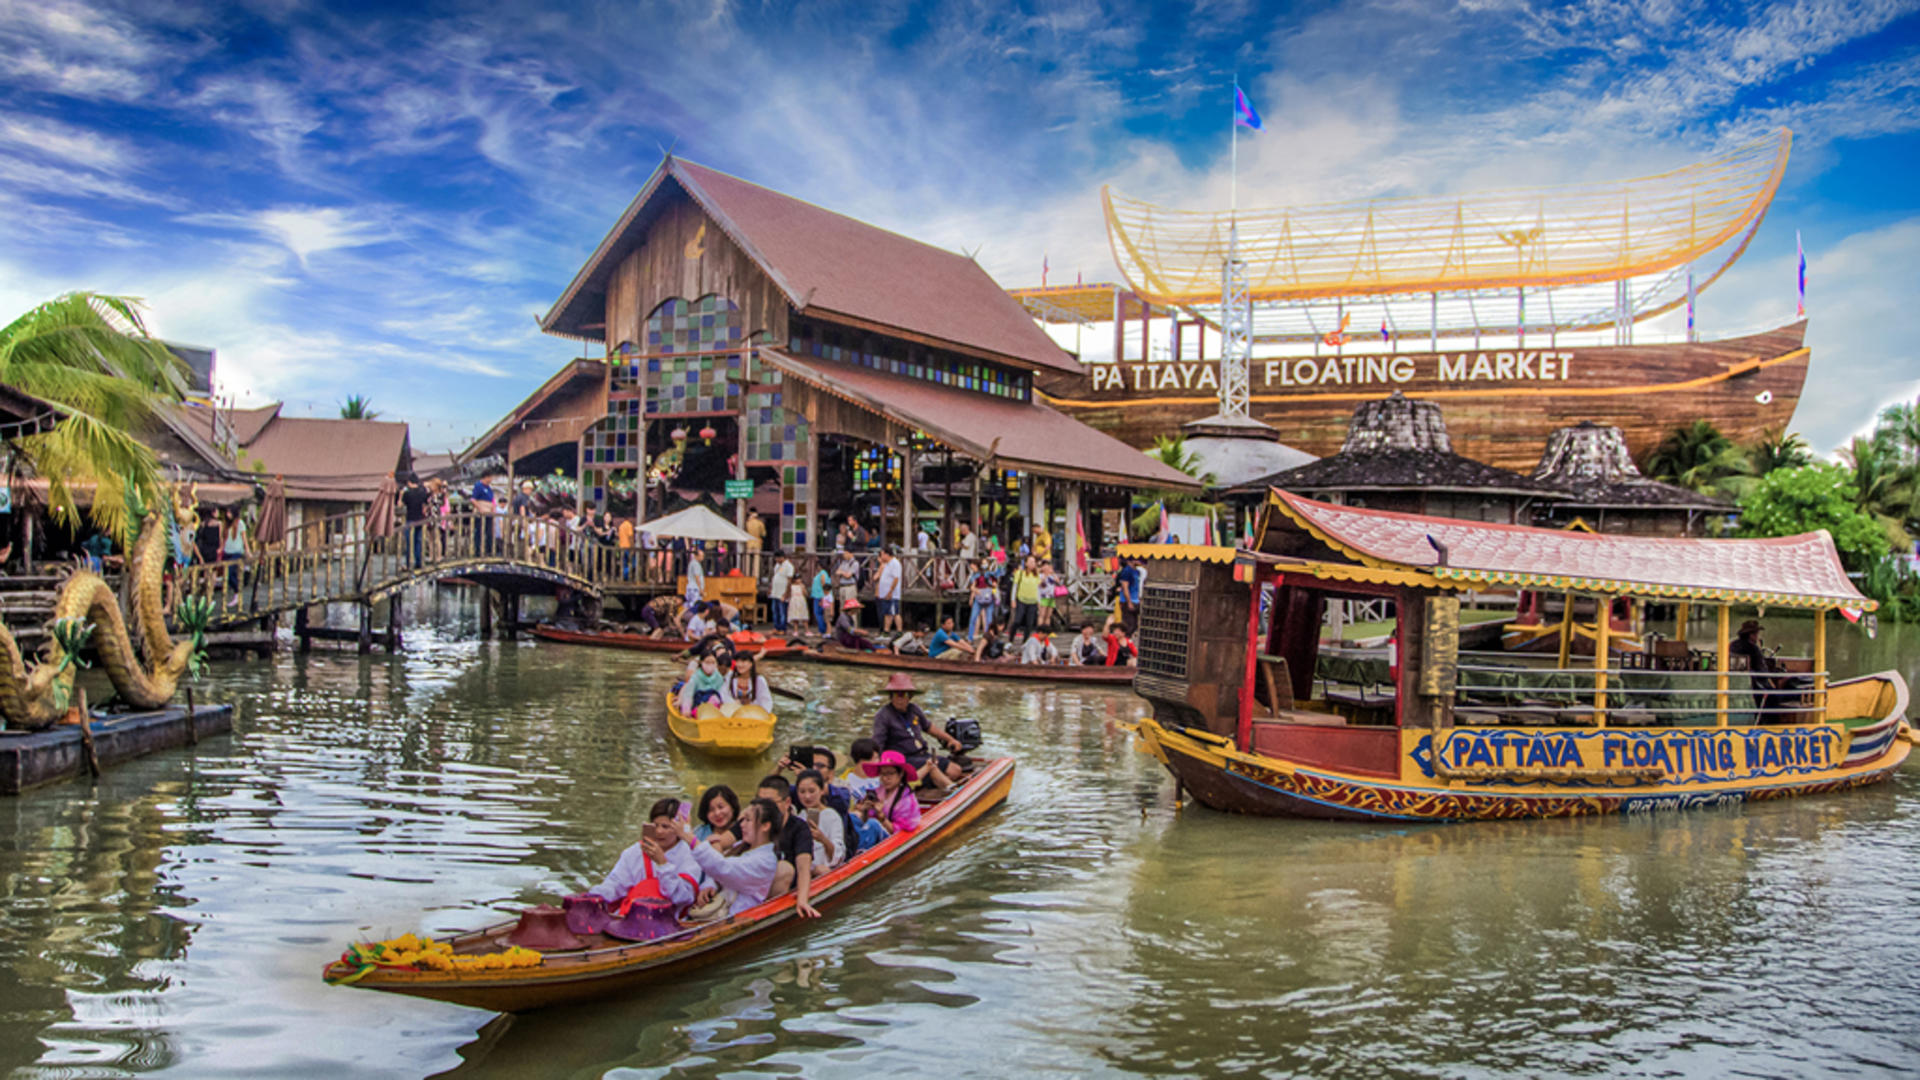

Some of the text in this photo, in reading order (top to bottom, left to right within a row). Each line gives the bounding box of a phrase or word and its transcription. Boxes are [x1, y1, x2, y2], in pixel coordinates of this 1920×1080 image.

[1093, 352, 1574, 391] PATTAYA FLOATING MARKET
[1453, 734, 1832, 774] PATTAYA FLOATING MARKET
